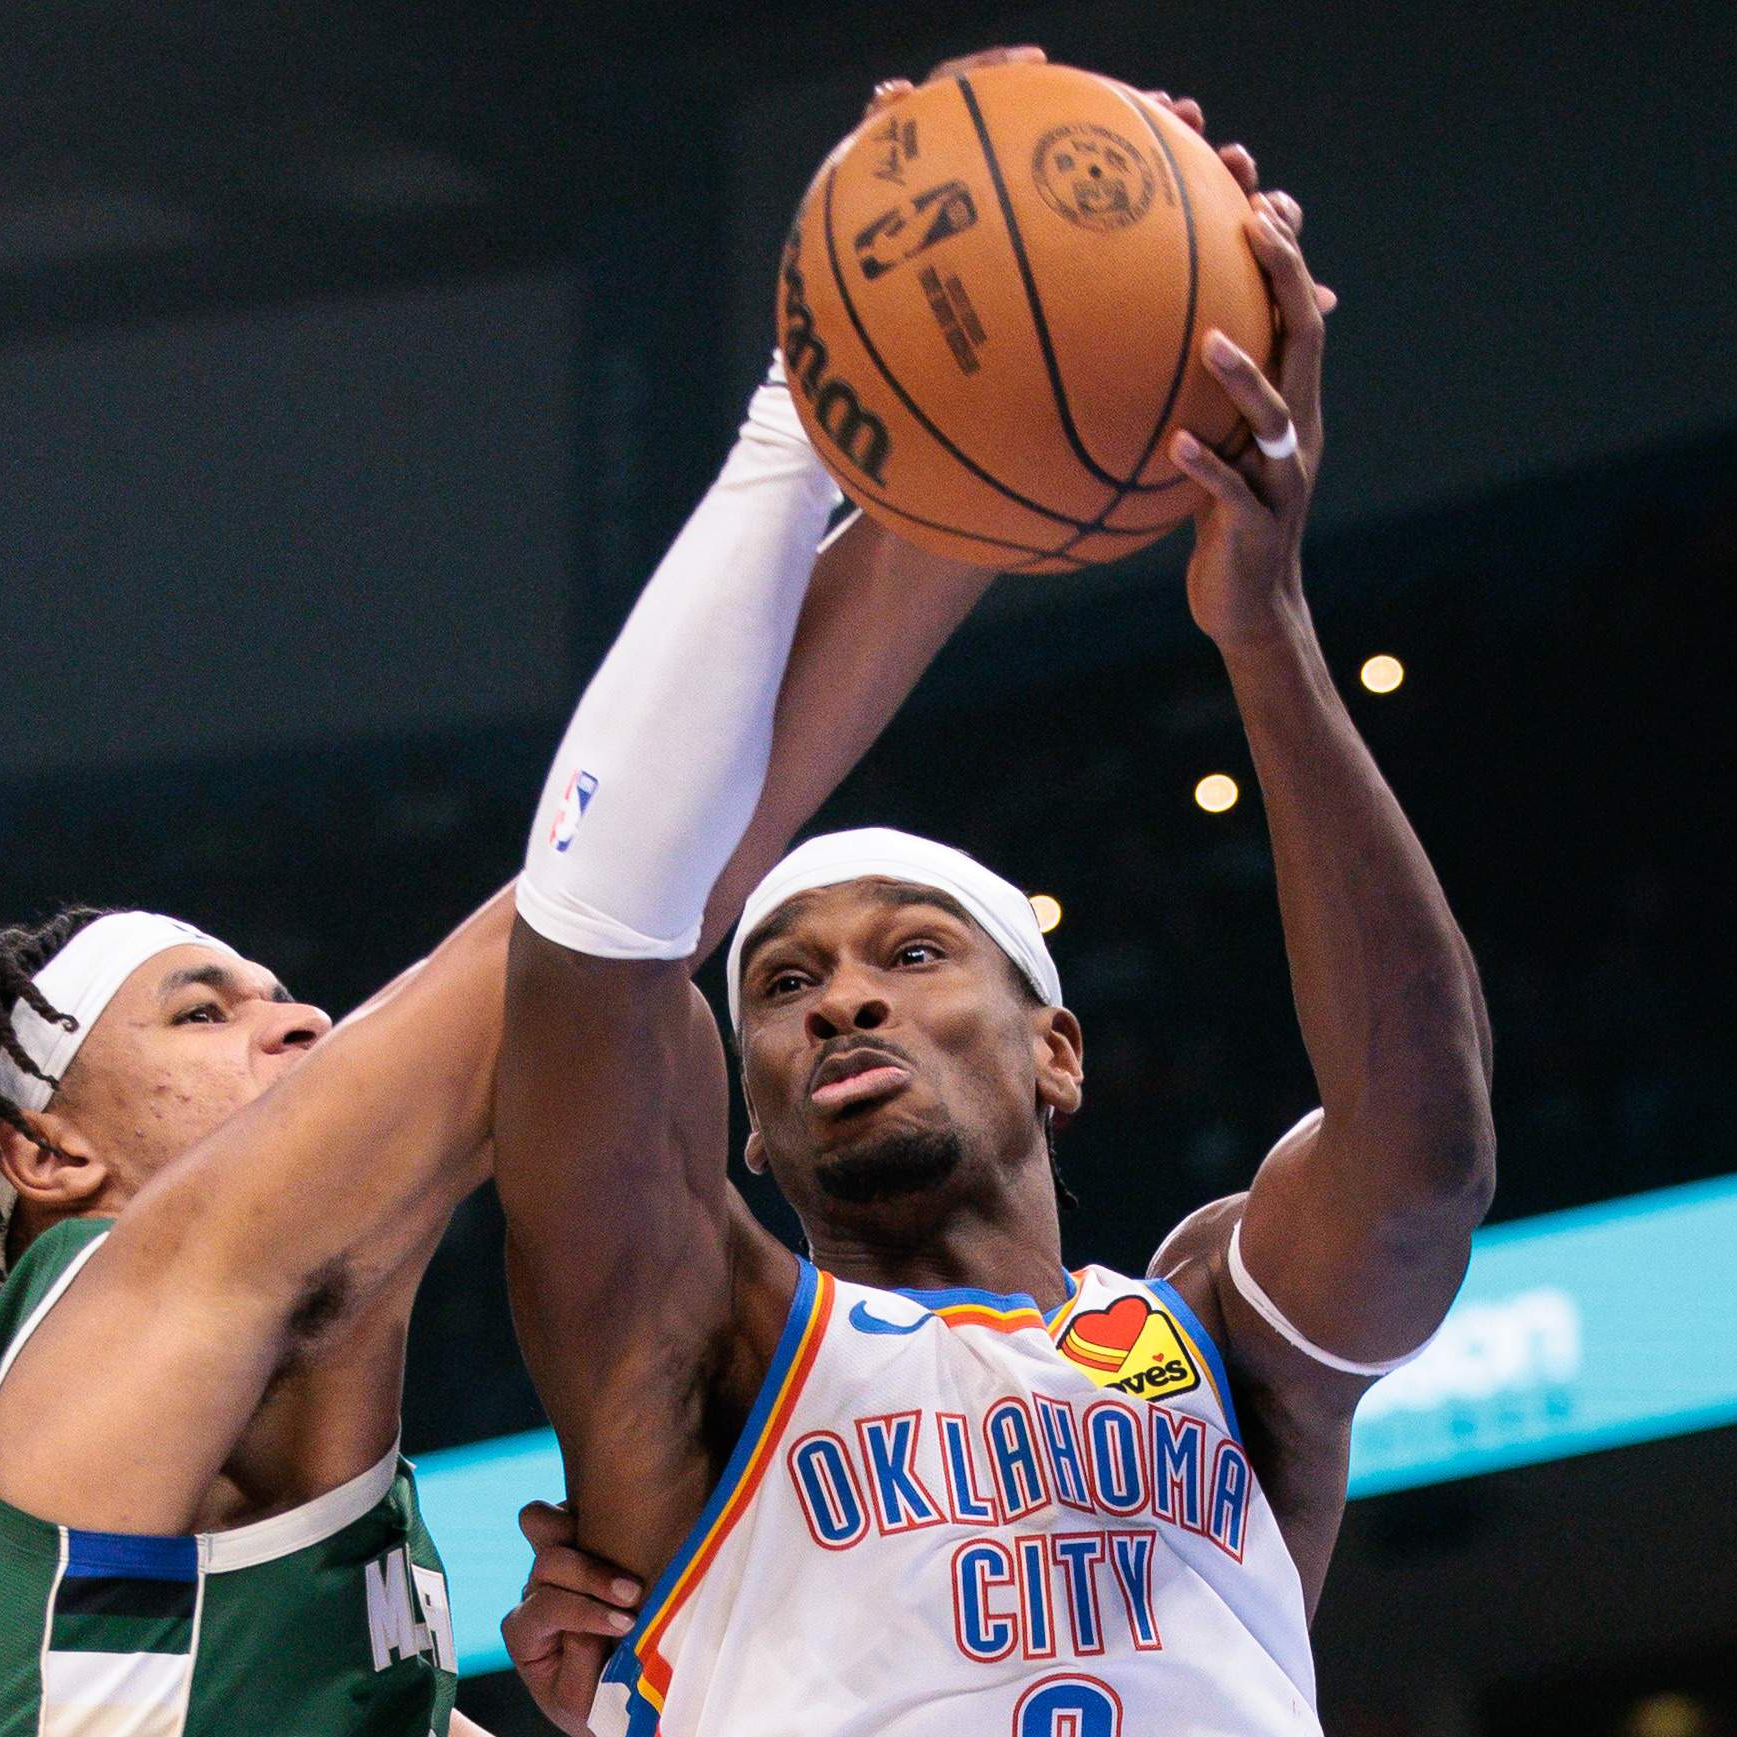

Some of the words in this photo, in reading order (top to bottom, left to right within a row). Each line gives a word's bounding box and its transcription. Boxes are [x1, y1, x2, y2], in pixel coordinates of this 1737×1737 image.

[1104, 1359, 1189, 1395] ves
[787, 1392, 1251, 1565] OKLAHOMA
[951, 1530, 1162, 1664] CITY
